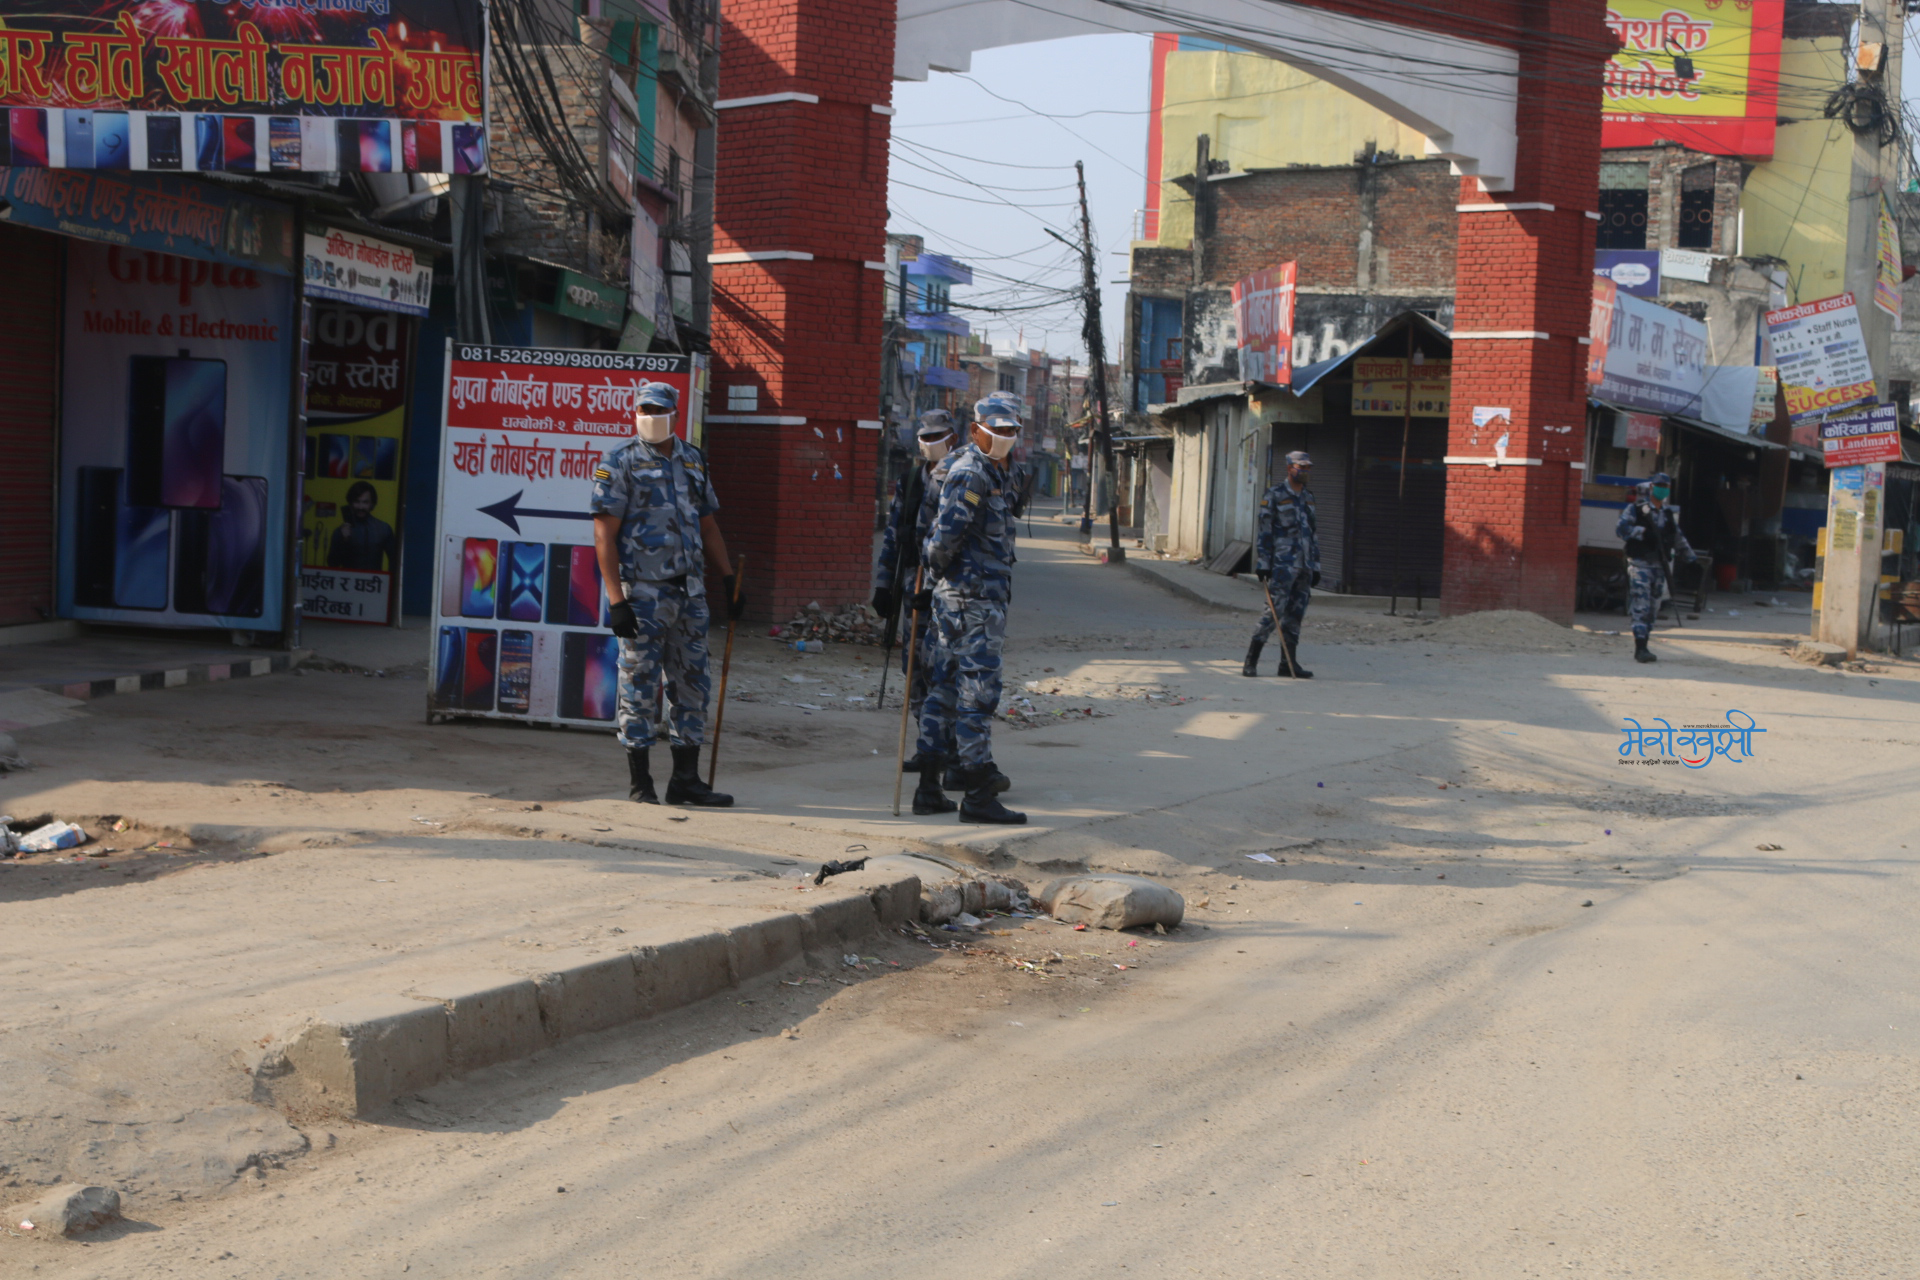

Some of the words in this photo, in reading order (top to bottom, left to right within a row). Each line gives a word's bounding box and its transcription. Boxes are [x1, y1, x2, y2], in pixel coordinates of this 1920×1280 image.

[63, 11, 145, 103] हातै
[156, 22, 268, 102] खाली
[279, 28, 397, 106] नजाने
[567, 285, 598, 307] oppo
[1767, 303, 1815, 324] लोकसेवा
[1818, 294, 1852, 312] तयारी
[83, 310, 152, 335] Mobile
[157, 313, 173, 336] &
[180, 313, 279, 341] Electronic
[1812, 322, 1831, 334] Staff
[1833, 317, 1857, 329] Nurse
[345, 355, 400, 391] स्टोर्स
[461, 346, 679, 372] 081-526299/9800547997
[1356, 358, 1403, 378] बागेश्वरी
[452, 376, 488, 410] गुप्ता
[490, 371, 549, 410] मोबाईल
[552, 382, 584, 409] एण्ड
[1787, 381, 1874, 414] SUCCESS
[573, 418, 632, 435] नेपालगंज
[1824, 423, 1868, 438] कोरियन
[1870, 420, 1895, 433] भाषा
[1838, 434, 1898, 450] Landmark
[453, 433, 486, 477] यहाँ
[490, 434, 556, 483] मोबाईल
